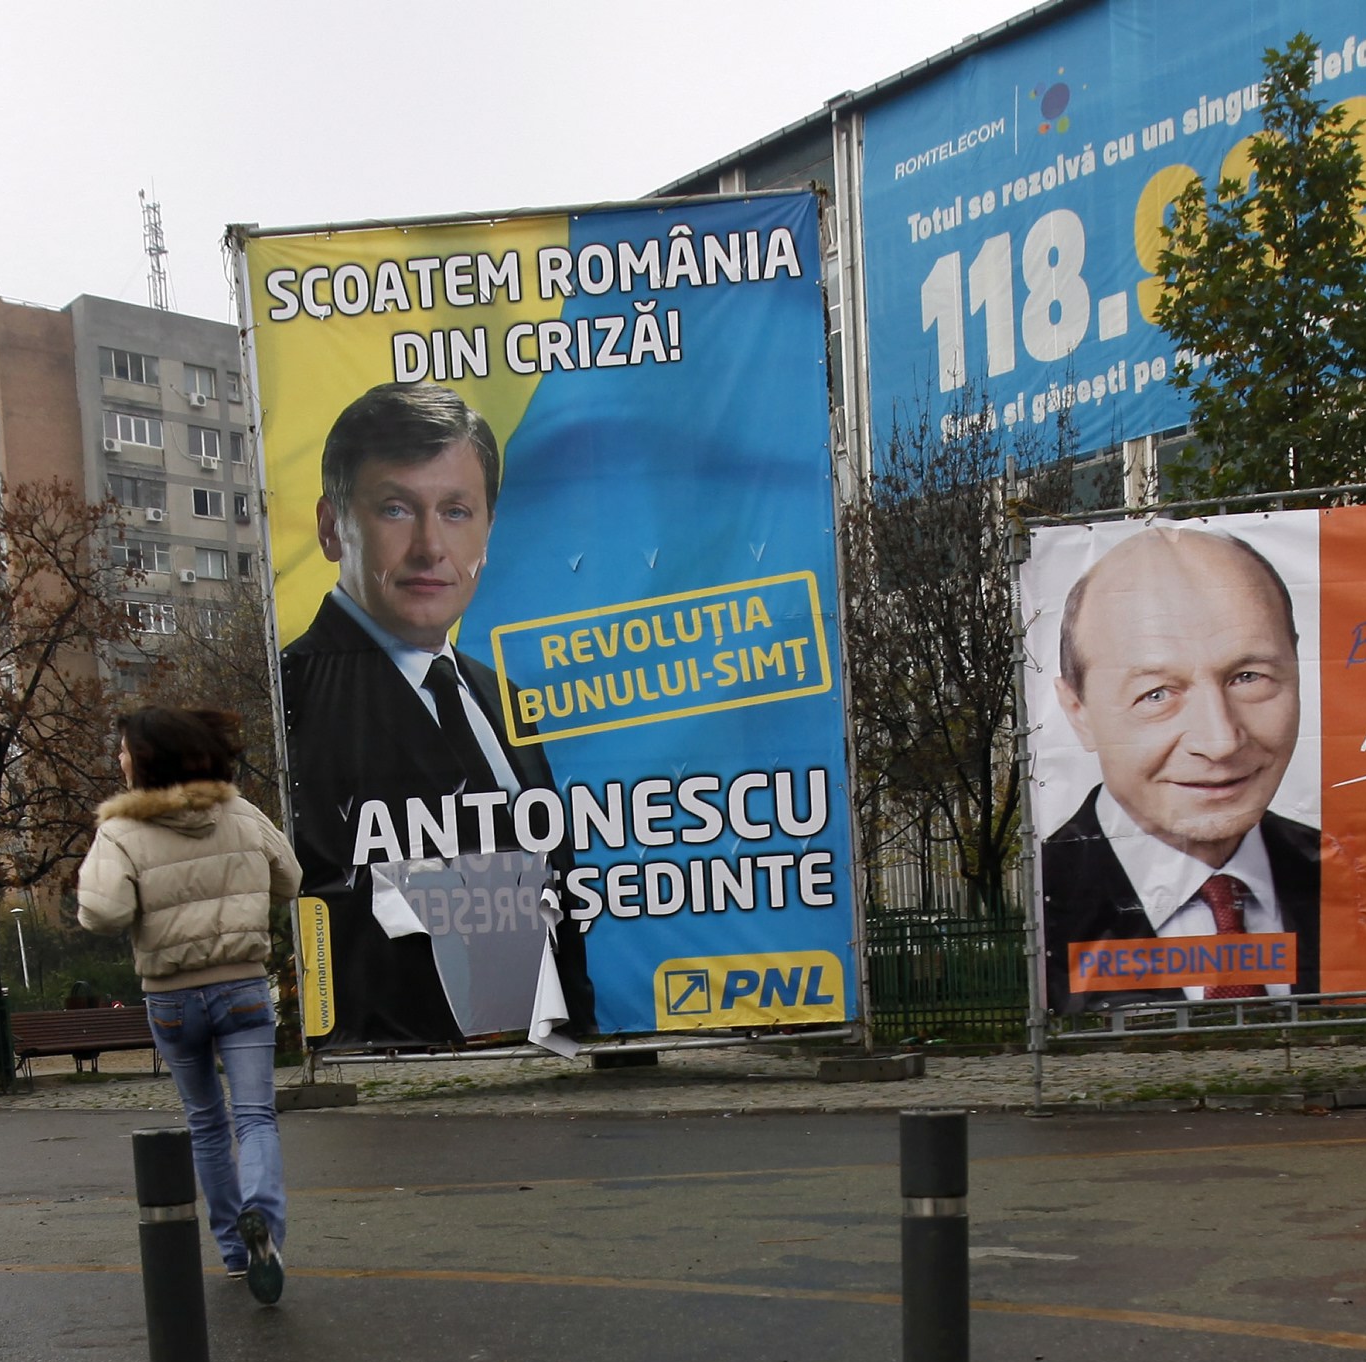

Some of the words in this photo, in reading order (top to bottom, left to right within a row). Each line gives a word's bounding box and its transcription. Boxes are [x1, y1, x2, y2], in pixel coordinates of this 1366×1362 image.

[894, 117, 1006, 181] ROMTELECOM
[907, 195, 963, 244] Totul
[968, 189, 996, 221] se
[1002, 142, 1096, 207] rezolvă
[1103, 133, 1135, 167] cu
[1141, 117, 1175, 151] un
[266, 249, 522, 321] SCOATEM
[537, 223, 804, 300] ROMÂNIA
[392, 325, 489, 384] DIN
[506, 300, 682, 375] CRIZĂ!
[1133, 356, 1167, 394] pe
[540, 595, 774, 670] REVOLUȚIA
[517, 636, 809, 724] BUNULUI-SIMȚ
[352, 768, 829, 867] ANTONESCU
[551, 851, 835, 935] ȘEDINTE
[314, 903, 330, 1030] www.crinantonescu.ro
[720, 966, 835, 1011] PNL
[1078, 942, 1288, 982] PREȘEDINTELE
